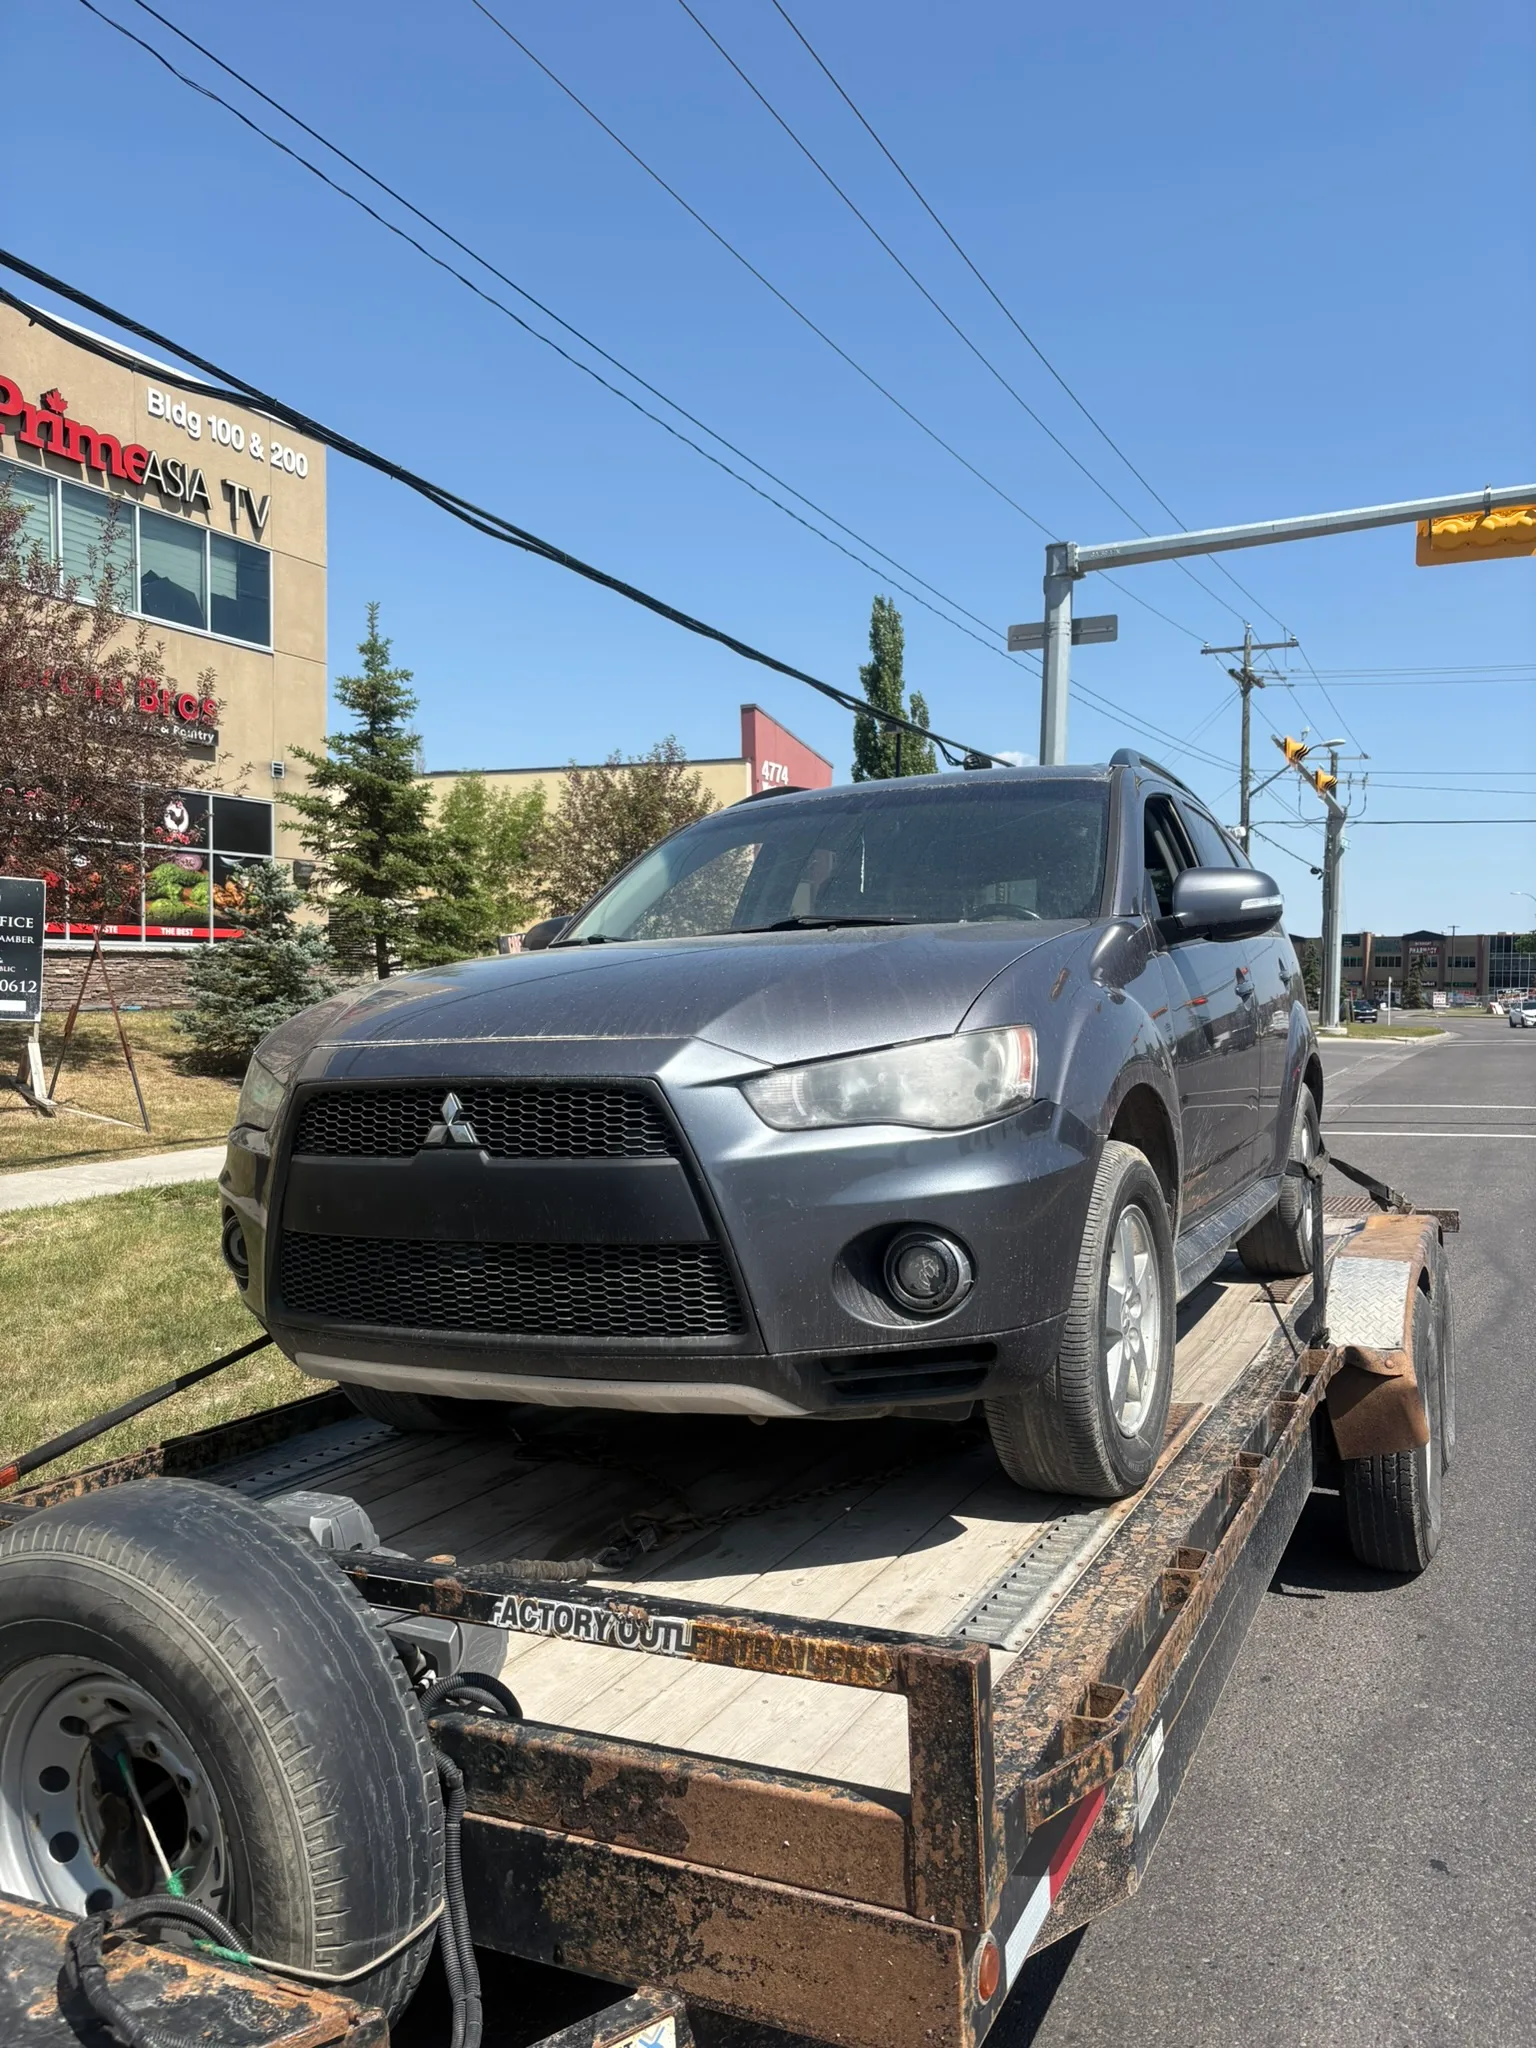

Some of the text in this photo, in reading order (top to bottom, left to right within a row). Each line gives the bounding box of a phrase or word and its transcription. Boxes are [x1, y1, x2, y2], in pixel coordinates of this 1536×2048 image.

[147, 387, 309, 478] Bldg 100 & 200
[142, 450, 213, 510] ASIA
[225, 479, 272, 528] TV
[761, 759, 789, 785] 4774
[0, 915, 34, 928] FICE
[93, 924, 119, 934] TSTE
[160, 927, 194, 936] THE BEST
[0, 978, 37, 993] 0612
[488, 1595, 616, 1642] FACTORY
